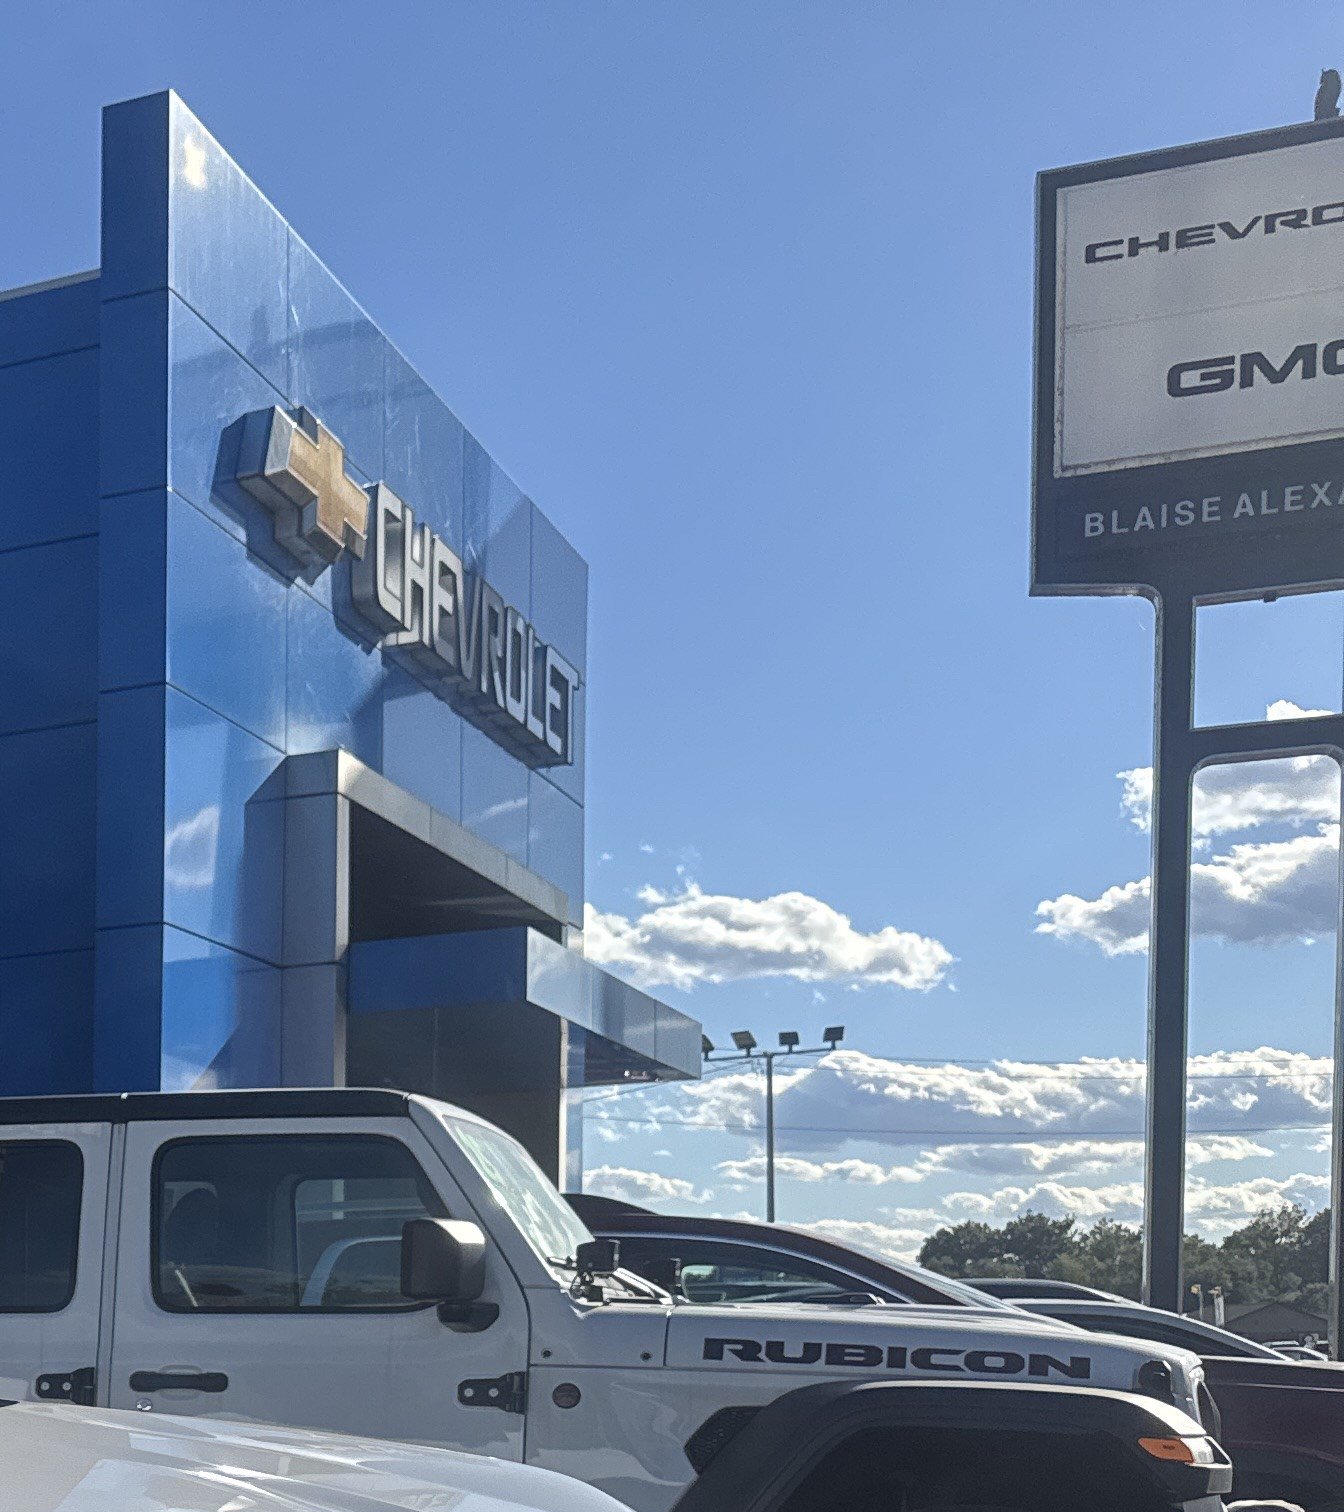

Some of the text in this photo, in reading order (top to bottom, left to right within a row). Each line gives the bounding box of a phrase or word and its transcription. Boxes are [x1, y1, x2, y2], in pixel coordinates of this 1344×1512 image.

[1084, 481, 1344, 538] BLAISE ALEX
[374, 480, 581, 765] CHEVROLET
[702, 1337, 1092, 1380] RUBICON
